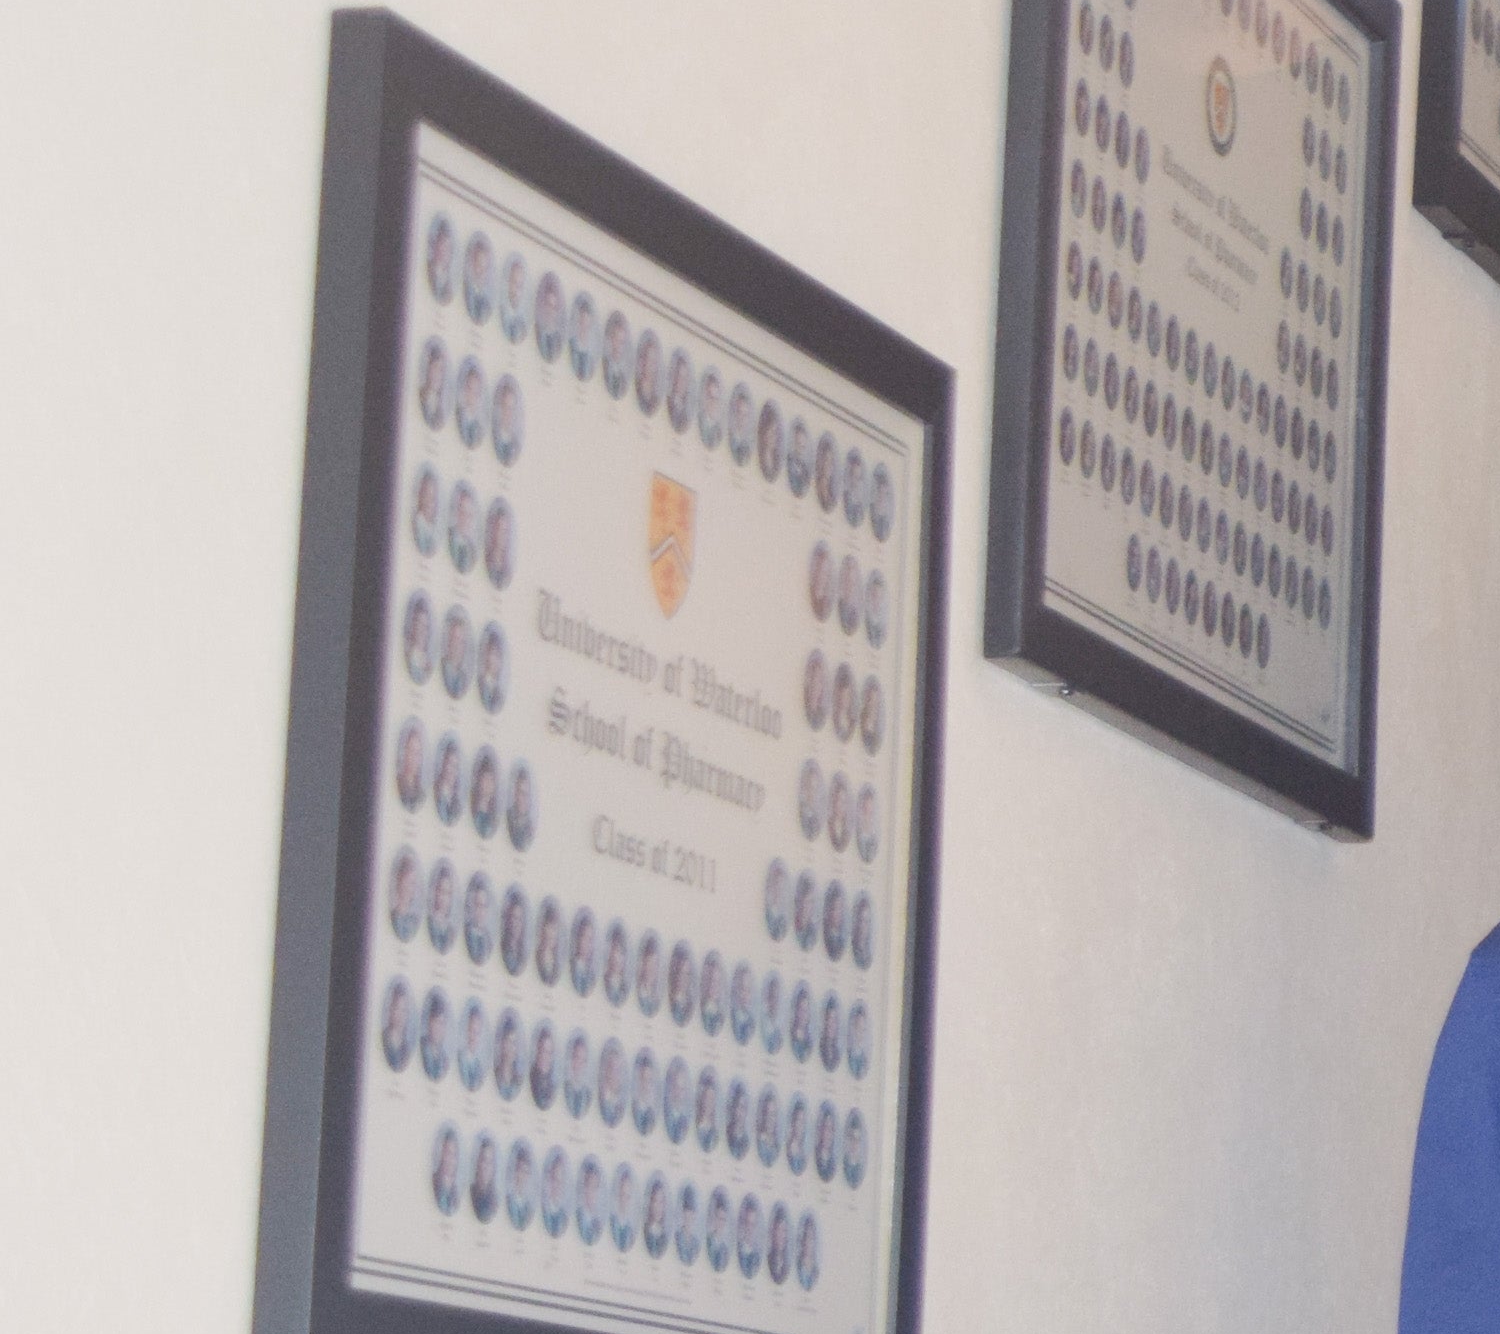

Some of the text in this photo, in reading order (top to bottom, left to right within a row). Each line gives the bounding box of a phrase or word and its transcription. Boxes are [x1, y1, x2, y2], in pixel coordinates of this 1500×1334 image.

[538, 587, 783, 740] University of Waterloo
[548, 685, 767, 813] School of Pharmacy
[592, 814, 717, 894] Class of 2011
